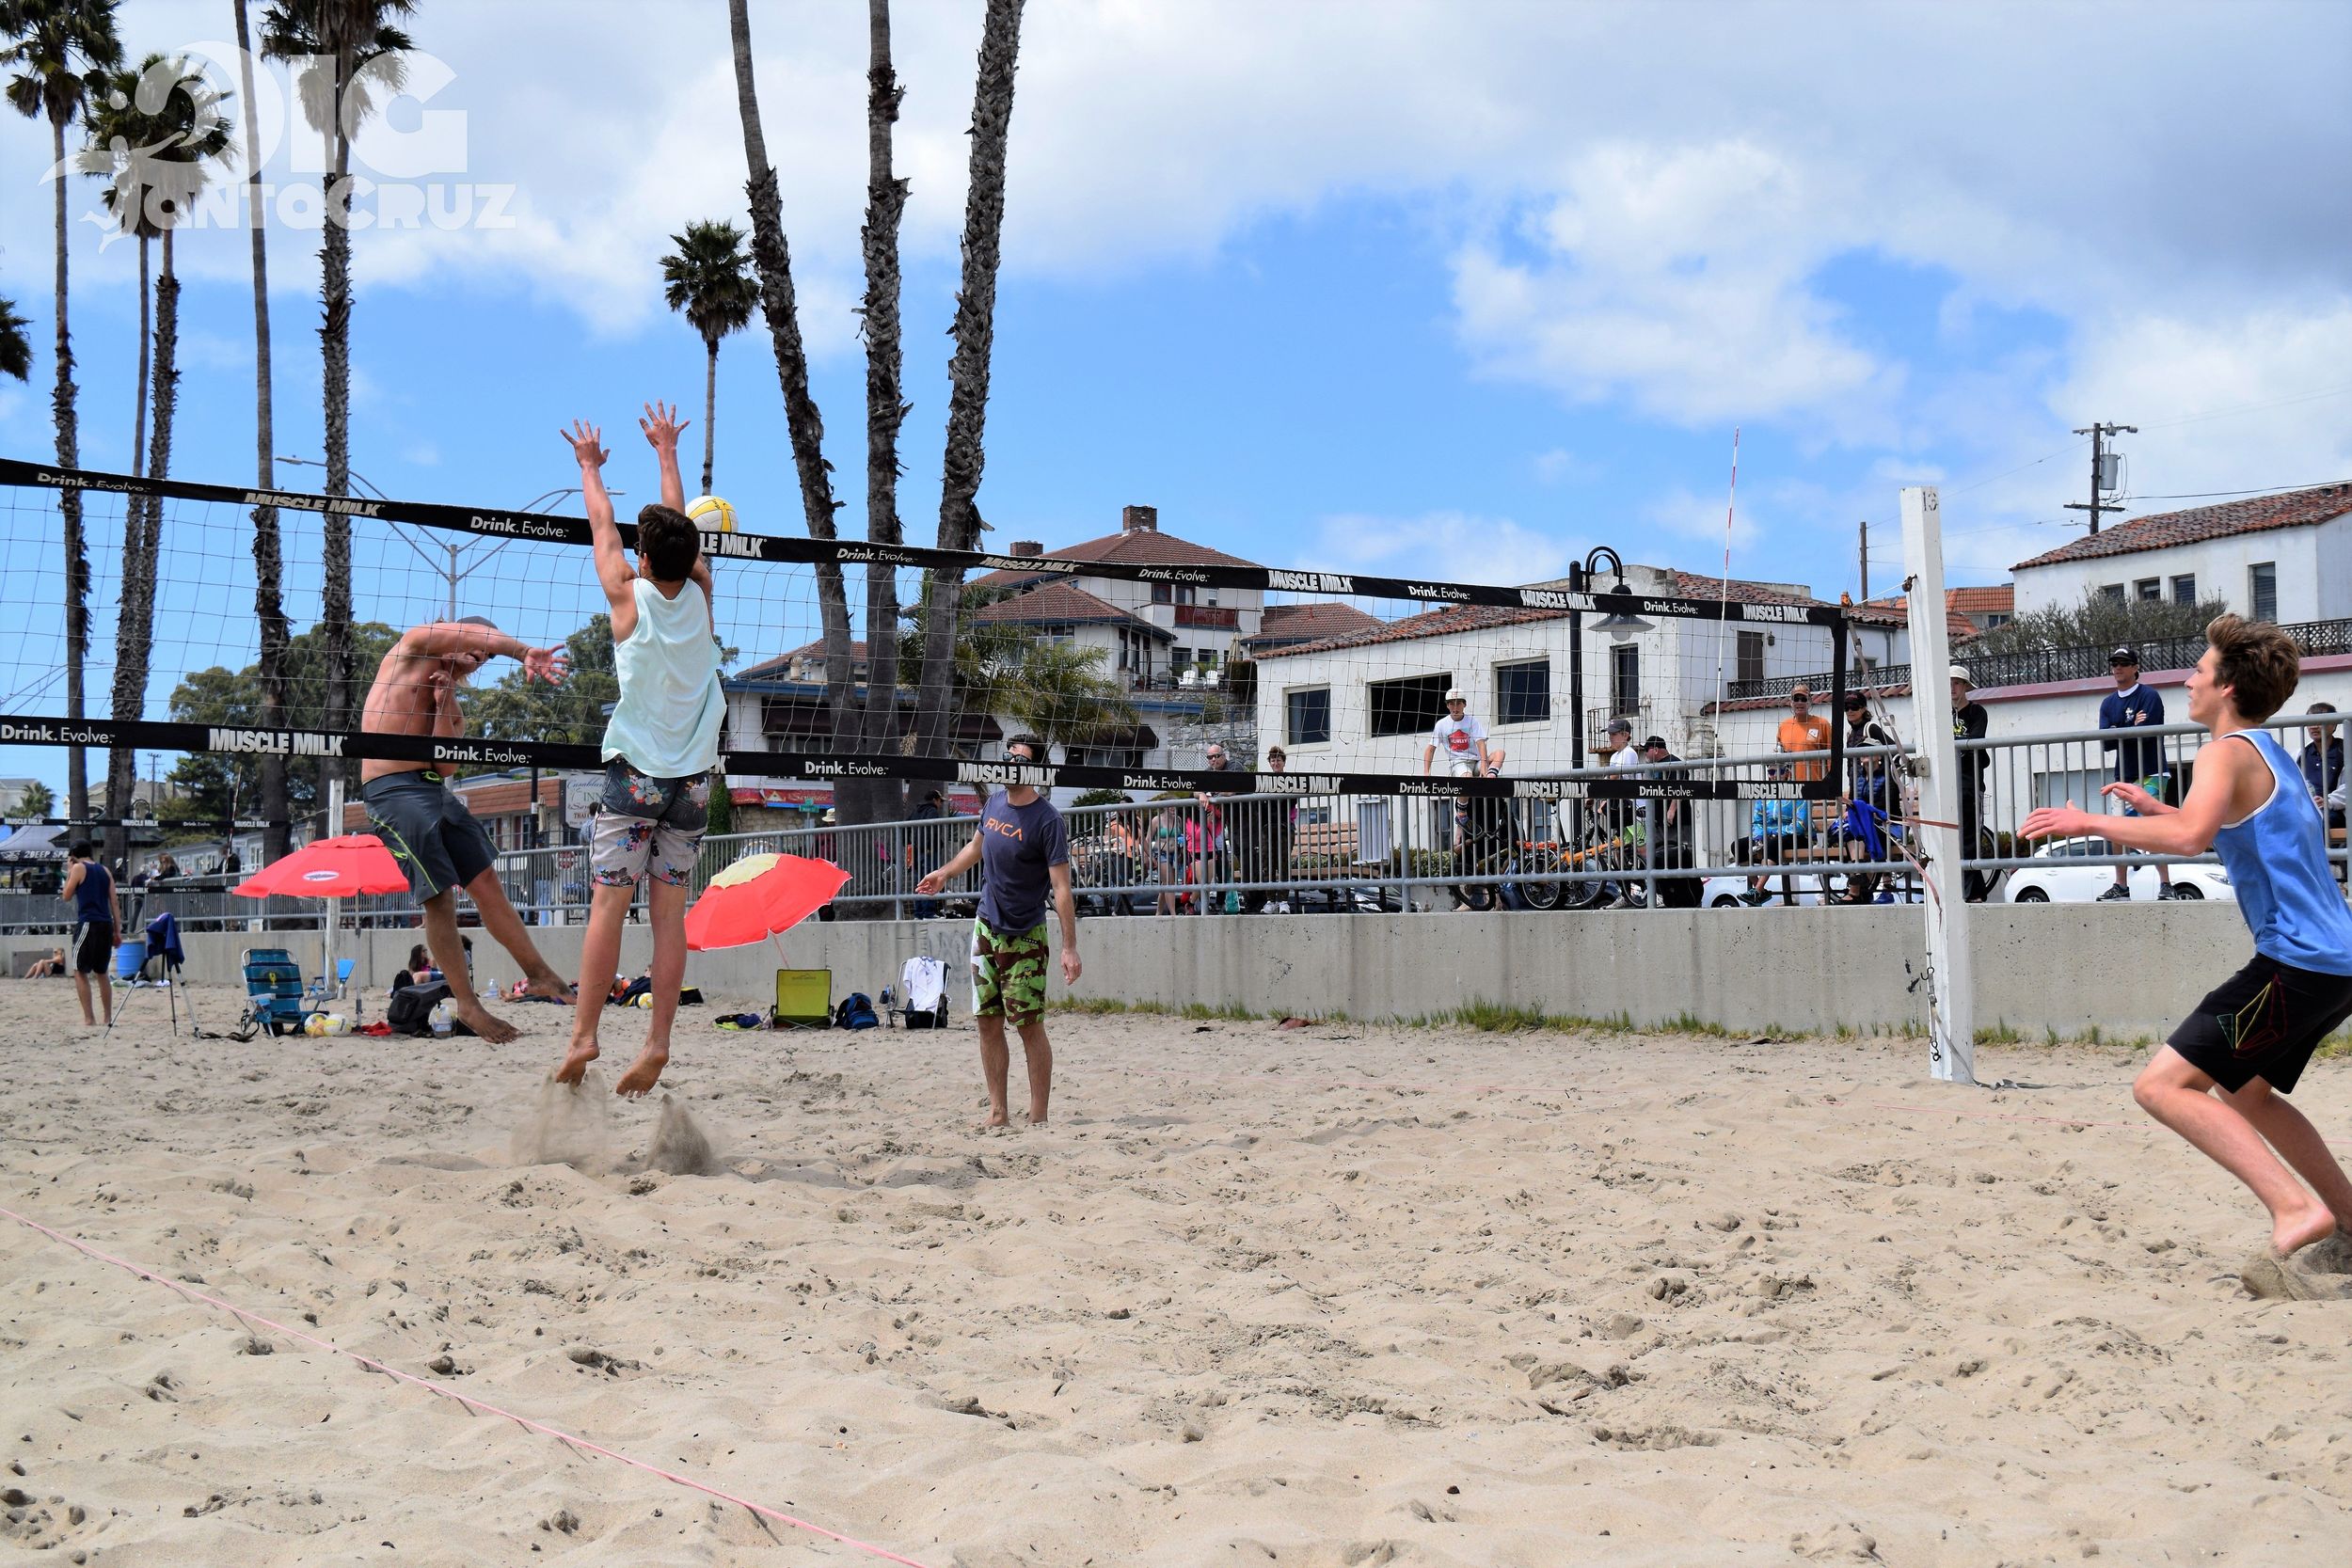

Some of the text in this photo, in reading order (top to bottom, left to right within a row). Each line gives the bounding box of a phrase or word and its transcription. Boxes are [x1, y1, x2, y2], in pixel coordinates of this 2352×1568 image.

[37, 472, 93, 487] Drink.
[244, 492, 382, 516] MUSCLE MILK
[470, 515, 519, 533] Drink.
[720, 532, 763, 558] MILK
[836, 547, 876, 561] Drink.
[979, 556, 1043, 570] MUSCLE
[1137, 568, 1173, 579] Drink.
[1267, 569, 1353, 593] MUSCLE MILK
[1407, 585, 1440, 598] Drink.
[1519, 589, 1597, 610] MUSCLE MILK
[1644, 600, 1673, 613] Drink.
[1741, 603, 1809, 623] MUSCLE MILK
[1, 724, 57, 741] Drink.
[209, 728, 343, 756] MUSCLE MILK
[434, 745, 483, 761] Drink.
[804, 760, 847, 775] Drink.
[957, 762, 1057, 786] MUSCLE MILK
[1123, 775, 1160, 788] Drink.
[1255, 774, 1342, 794] MUSCLE MILK
[1399, 782, 1431, 794] Drink.
[1513, 781, 1589, 799] MUSCLE MILK
[1639, 784, 1666, 797] Drink.
[1737, 782, 1803, 799] MUSCLE MILK
[985, 817, 1023, 842] RVCA
[53, 850, 70, 859] SPO
